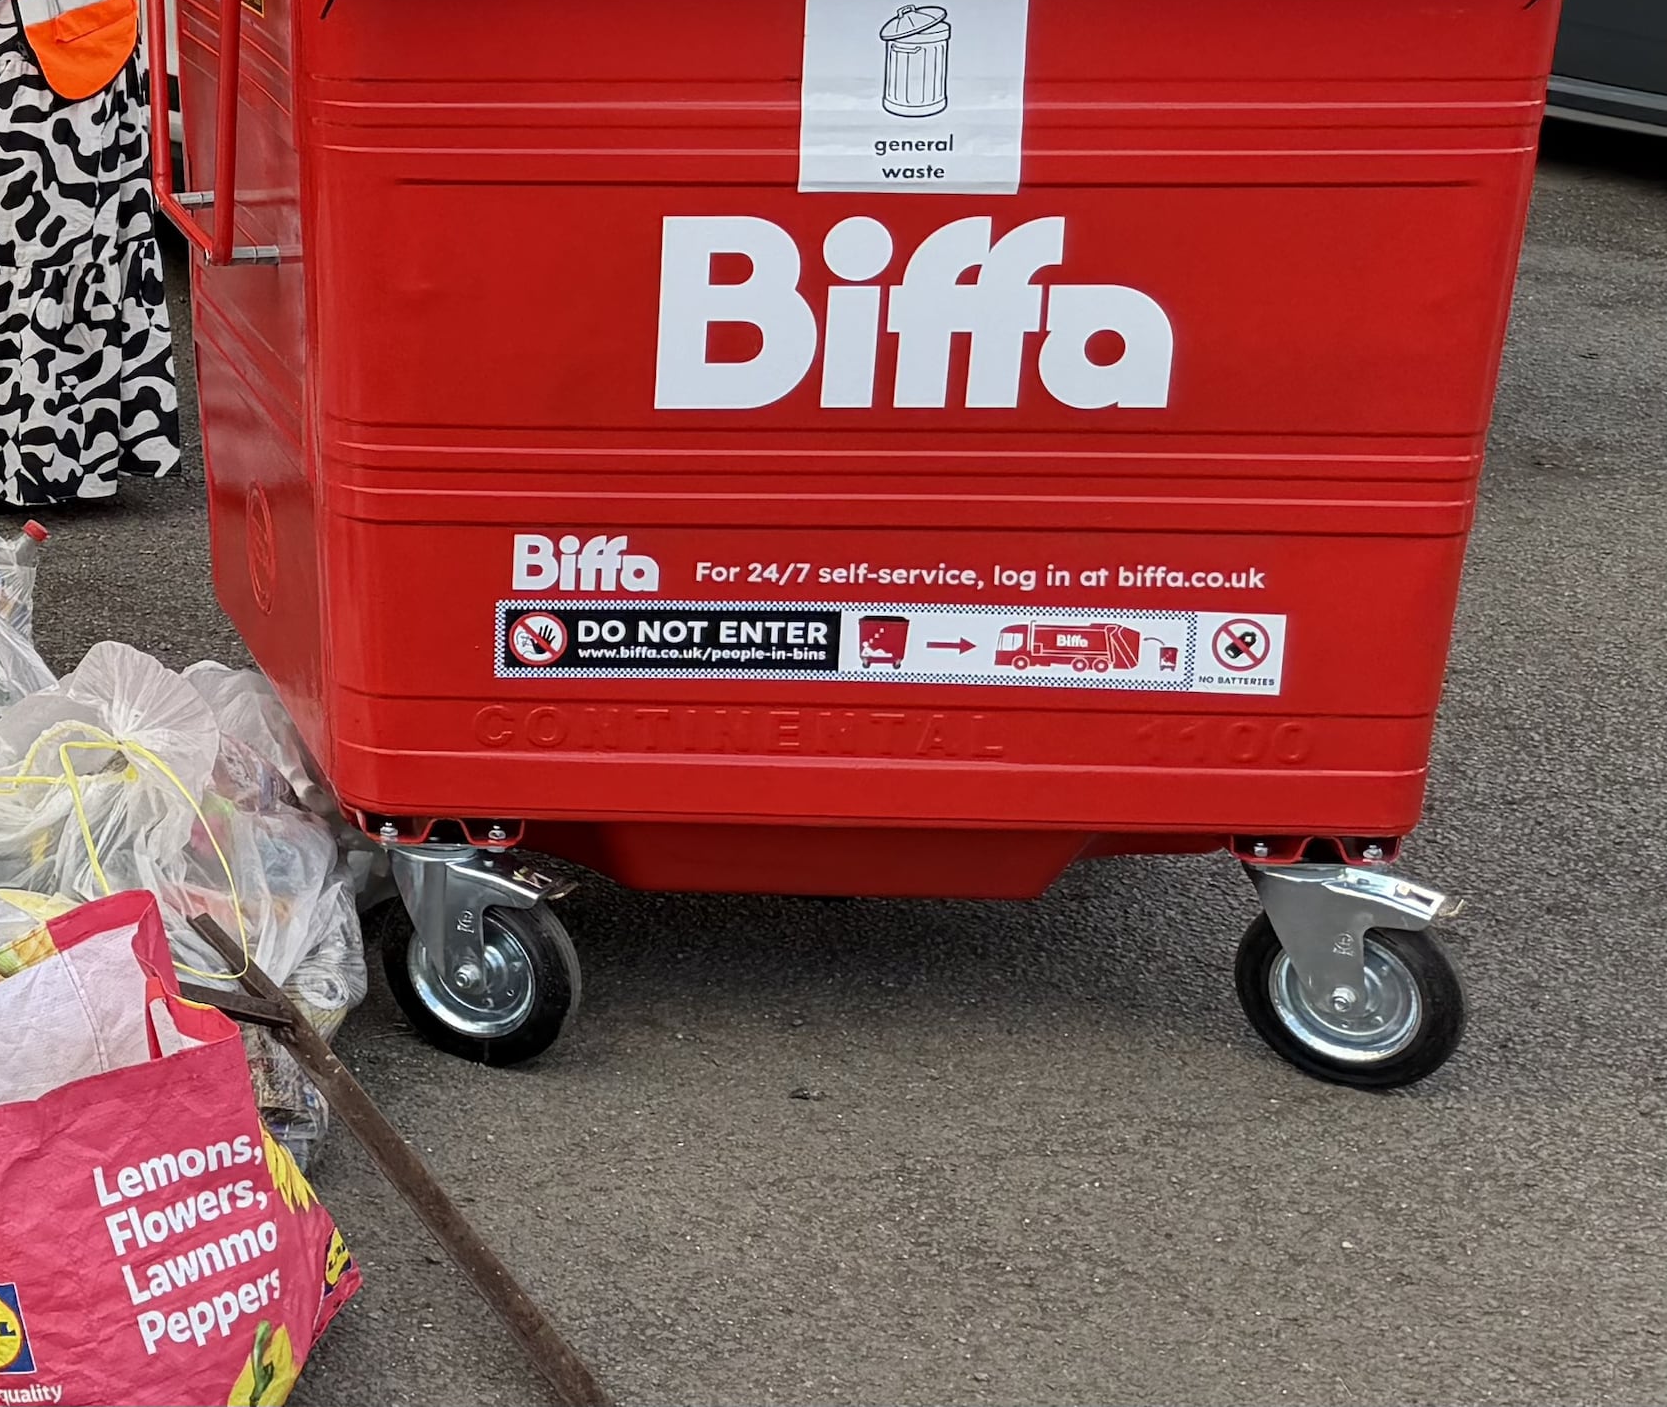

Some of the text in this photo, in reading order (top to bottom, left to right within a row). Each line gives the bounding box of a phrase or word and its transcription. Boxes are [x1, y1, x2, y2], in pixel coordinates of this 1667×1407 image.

[874, 133, 953, 156] general
[881, 165, 945, 179] waste
[654, 216, 1174, 409] Biffa
[512, 534, 660, 592] Biffa
[695, 561, 1266, 592] For 24/7 self-service, log in at biffa.co.uk
[577, 619, 828, 645] DO NOT ENTER
[1056, 634, 1088, 648] Biffa
[577, 645, 827, 662] www.biffa.co.uk/people-in-bins
[1198, 675, 1275, 686] NO BATTERIES
[93, 1135, 263, 1208] Lemons,
[105, 1179, 268, 1257] Flowers,
[121, 1221, 277, 1306] Lawnmo
